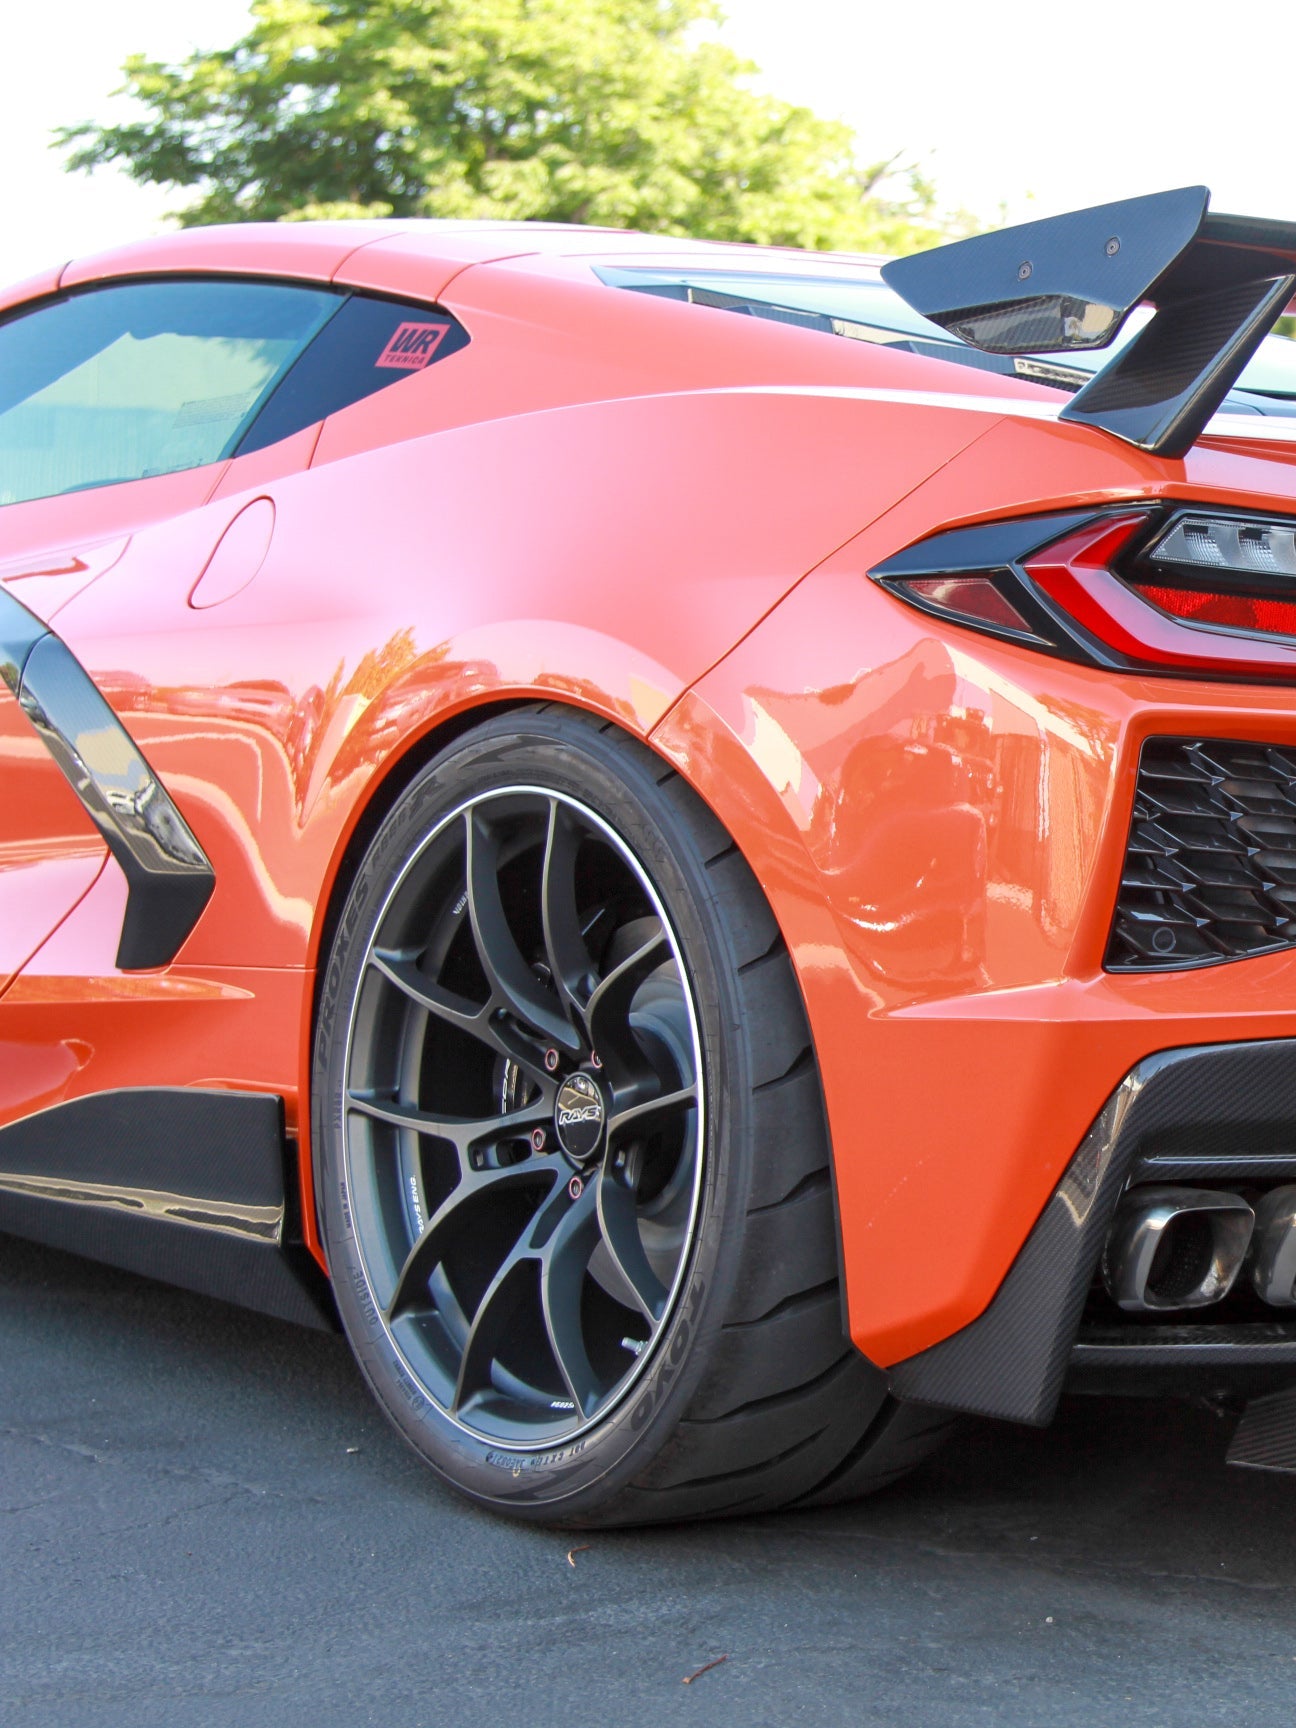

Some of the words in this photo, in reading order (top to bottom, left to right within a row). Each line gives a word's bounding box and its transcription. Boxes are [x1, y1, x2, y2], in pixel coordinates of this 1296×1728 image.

[388, 328, 440, 354] WR
[317, 872, 369, 1068] PROXES
[559, 1105, 601, 1125] RAYS
[630, 1279, 706, 1431] TOYO
